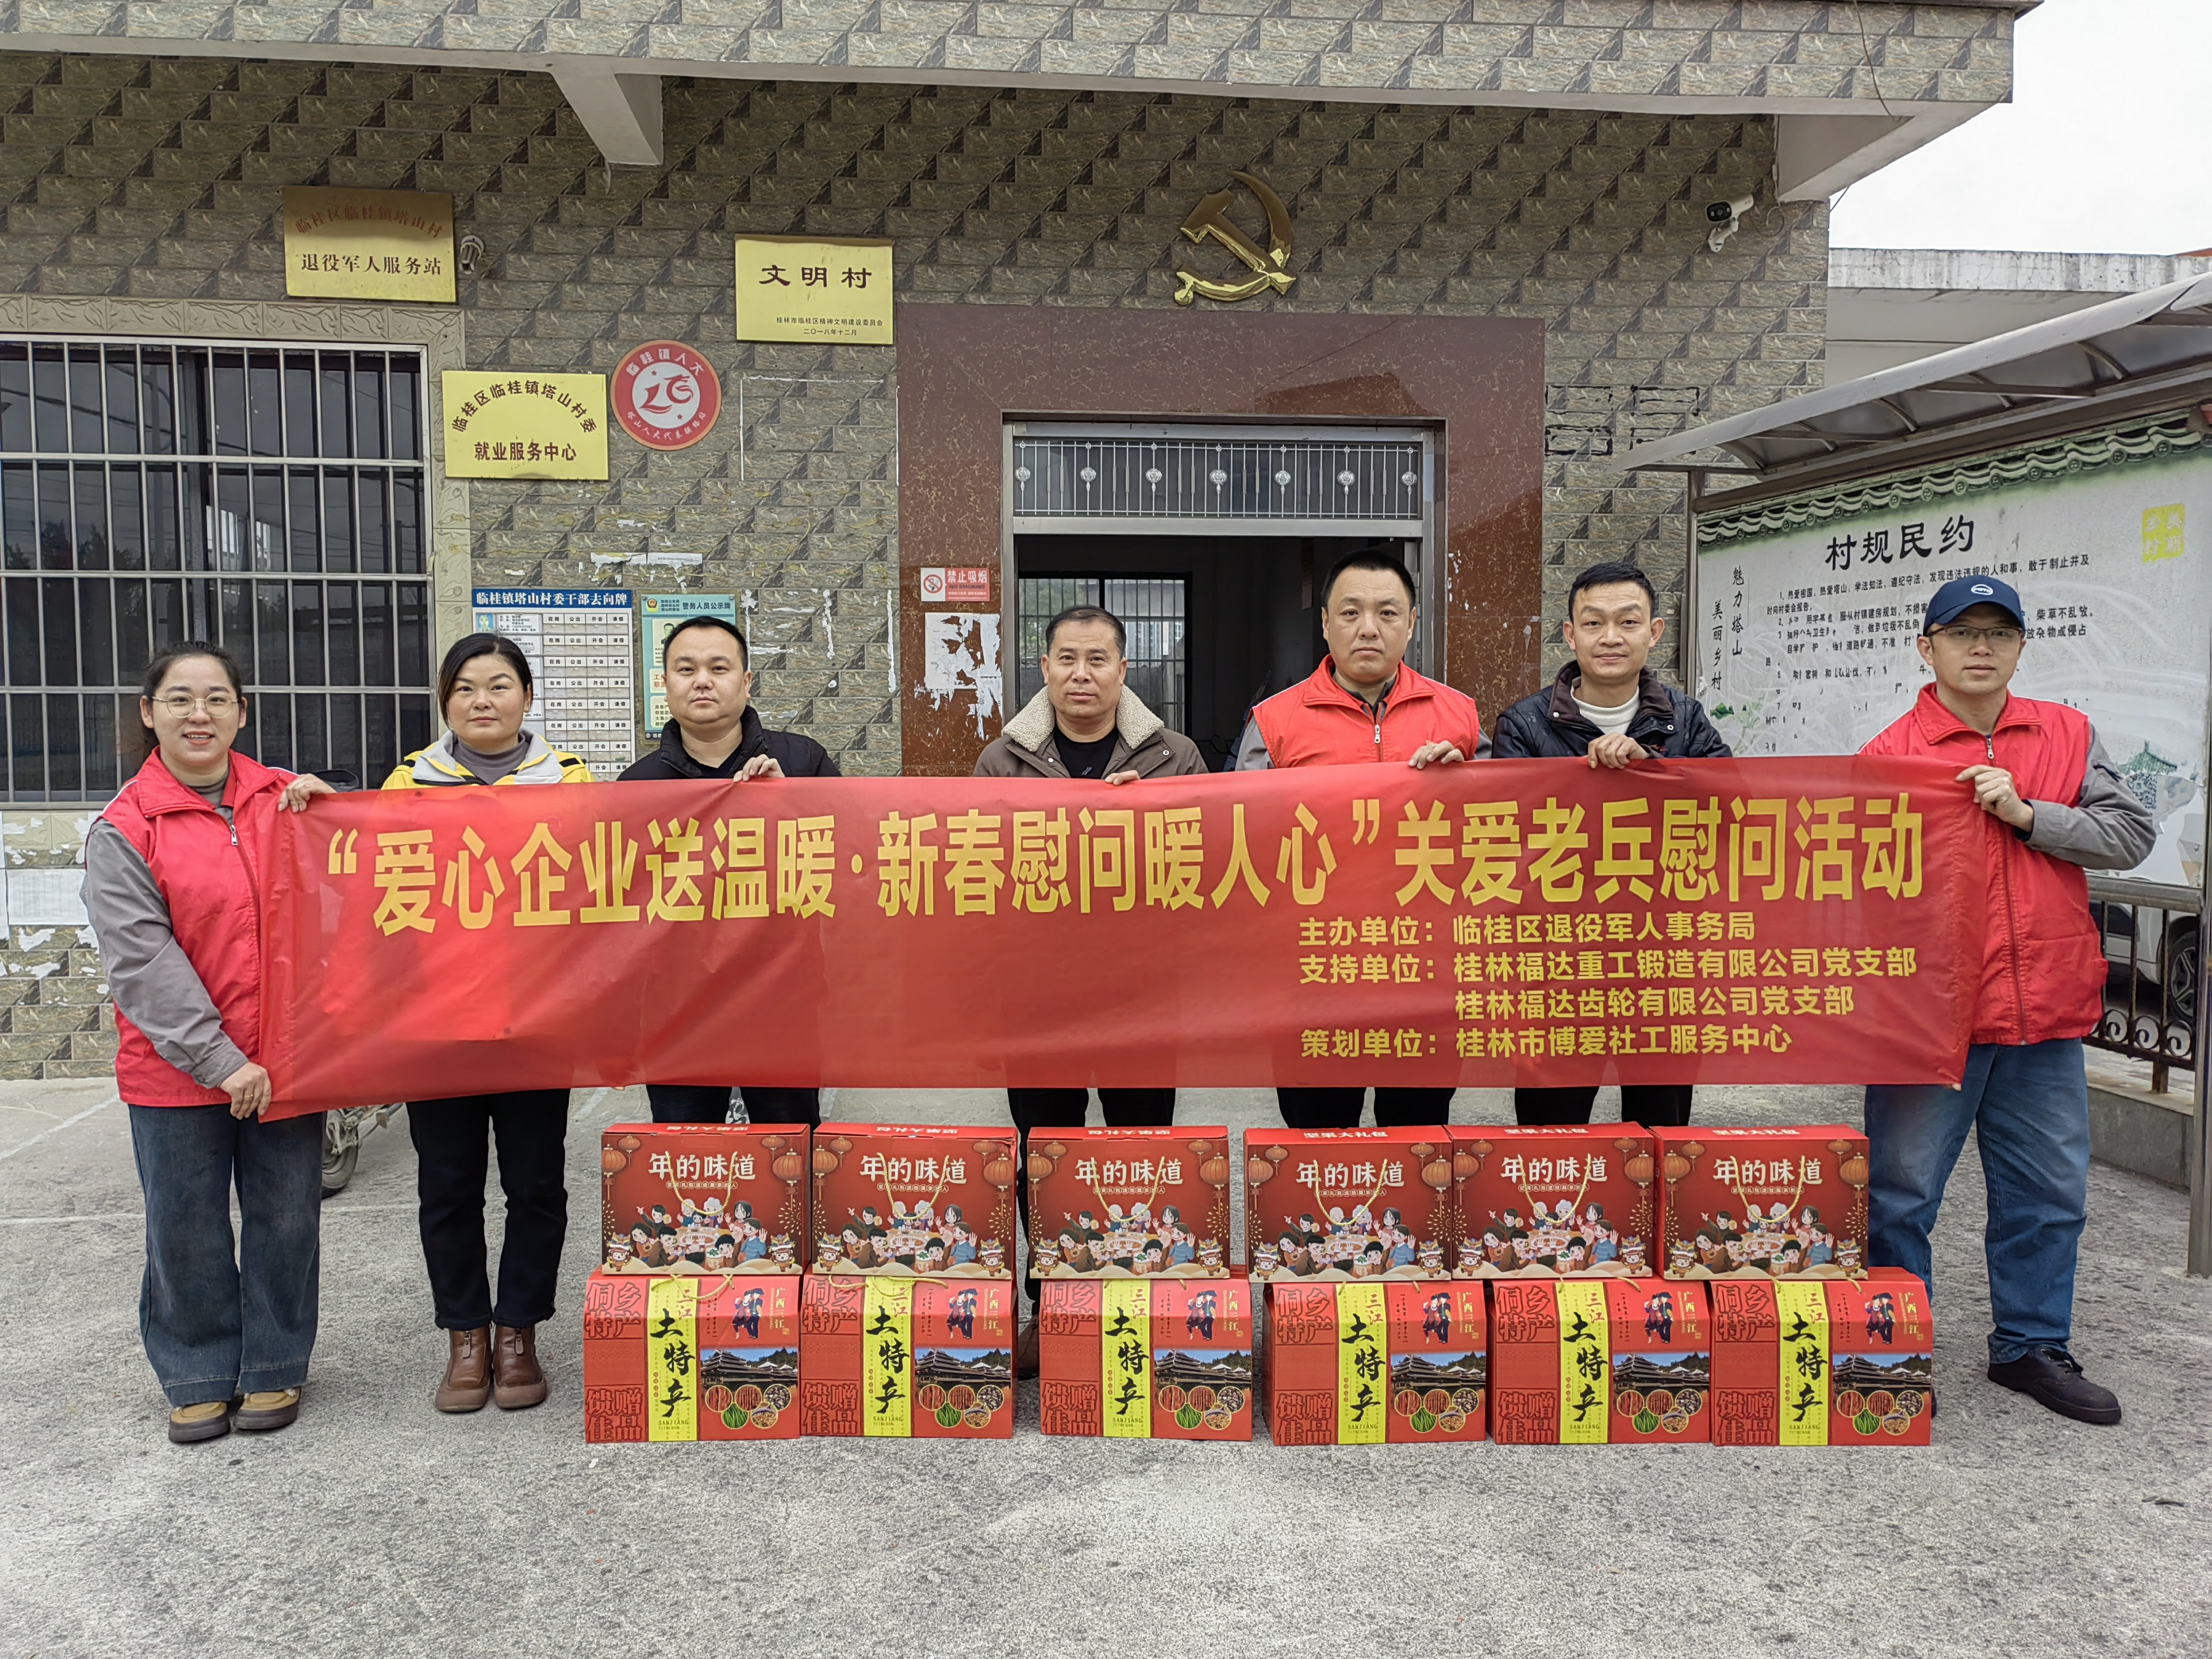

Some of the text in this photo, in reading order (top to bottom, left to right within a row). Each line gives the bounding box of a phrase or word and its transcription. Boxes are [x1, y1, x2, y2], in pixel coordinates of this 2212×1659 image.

[295, 205, 442, 238] 临桂区临桂镇塔山村
[301, 254, 441, 275] 退役军人服务站
[759, 265, 872, 288] 文明村
[777, 316, 883, 326] 桂林市临桂区精神文明建设委员会
[626, 348, 704, 376] 临桂镇人大
[452, 380, 597, 433] 临桂区临桂镇塔山村委
[475, 442, 577, 461] 就业服务中心
[1825, 515, 1974, 571] 村规民约
[947, 570, 987, 583] 禁止吸烟
[476, 592, 627, 605] 临桂镇塔山村委干部去向牌
[1731, 565, 1744, 656] 魅力塔山
[1711, 599, 1723, 690] 美丽乡村
[1455, 986, 1854, 1020] 桂林福达齿轮有限公司党支部
[649, 1153, 756, 1180] 年的味道
[860, 1155, 967, 1184] 年的味道
[1075, 1158, 1183, 1185] 年的味道
[1296, 1161, 1405, 1188] 年的味道
[1500, 1156, 1608, 1183] 年的味道
[1713, 1158, 1823, 1185] 年的味道
[677, 1289, 693, 1320] 三江
[775, 1287, 786, 1328] 广西三江
[892, 1287, 908, 1318] 三江
[989, 1289, 999, 1329] 广西三江
[1131, 1289, 1147, 1319] 三江
[1229, 1290, 1238, 1331] 广西三江
[1366, 1294, 1384, 1325] 三江
[1462, 1292, 1474, 1332] 广西三江
[1586, 1293, 1605, 1324] 三江
[1683, 1291, 1697, 1332] 广西三江
[1806, 1293, 1825, 1324] 三江
[1904, 1292, 1919, 1334] 广西三江
[586, 1311, 640, 1337] 特产
[803, 1306, 859, 1333] 特产
[1043, 1307, 1096, 1333] 特产
[1277, 1316, 1333, 1343] 特产
[1499, 1314, 1553, 1341] 特产
[1718, 1313, 1773, 1340] 特产
[650, 1309, 695, 1418] 土特产
[866, 1306, 909, 1414] 土特产
[1104, 1307, 1149, 1415] 土特产
[1341, 1314, 1385, 1422] 土特产
[1563, 1312, 1608, 1422] 土特产
[1783, 1312, 1827, 1422] 土特产
[586, 1388, 642, 1415] 馈赠
[802, 1383, 858, 1410] 馈赠
[1043, 1383, 1097, 1410] 馈赠
[1277, 1394, 1332, 1420] 馈赠
[1498, 1393, 1554, 1419] 馈赠
[1718, 1393, 1774, 1418] 馈赠
[588, 1414, 641, 1441] 佳品
[805, 1410, 858, 1435] 佳品
[1044, 1410, 1097, 1435] 佳品
[1278, 1420, 1331, 1445] 佳品
[1499, 1418, 1553, 1443] 佳品
[1719, 1418, 1772, 1444] 佳品
